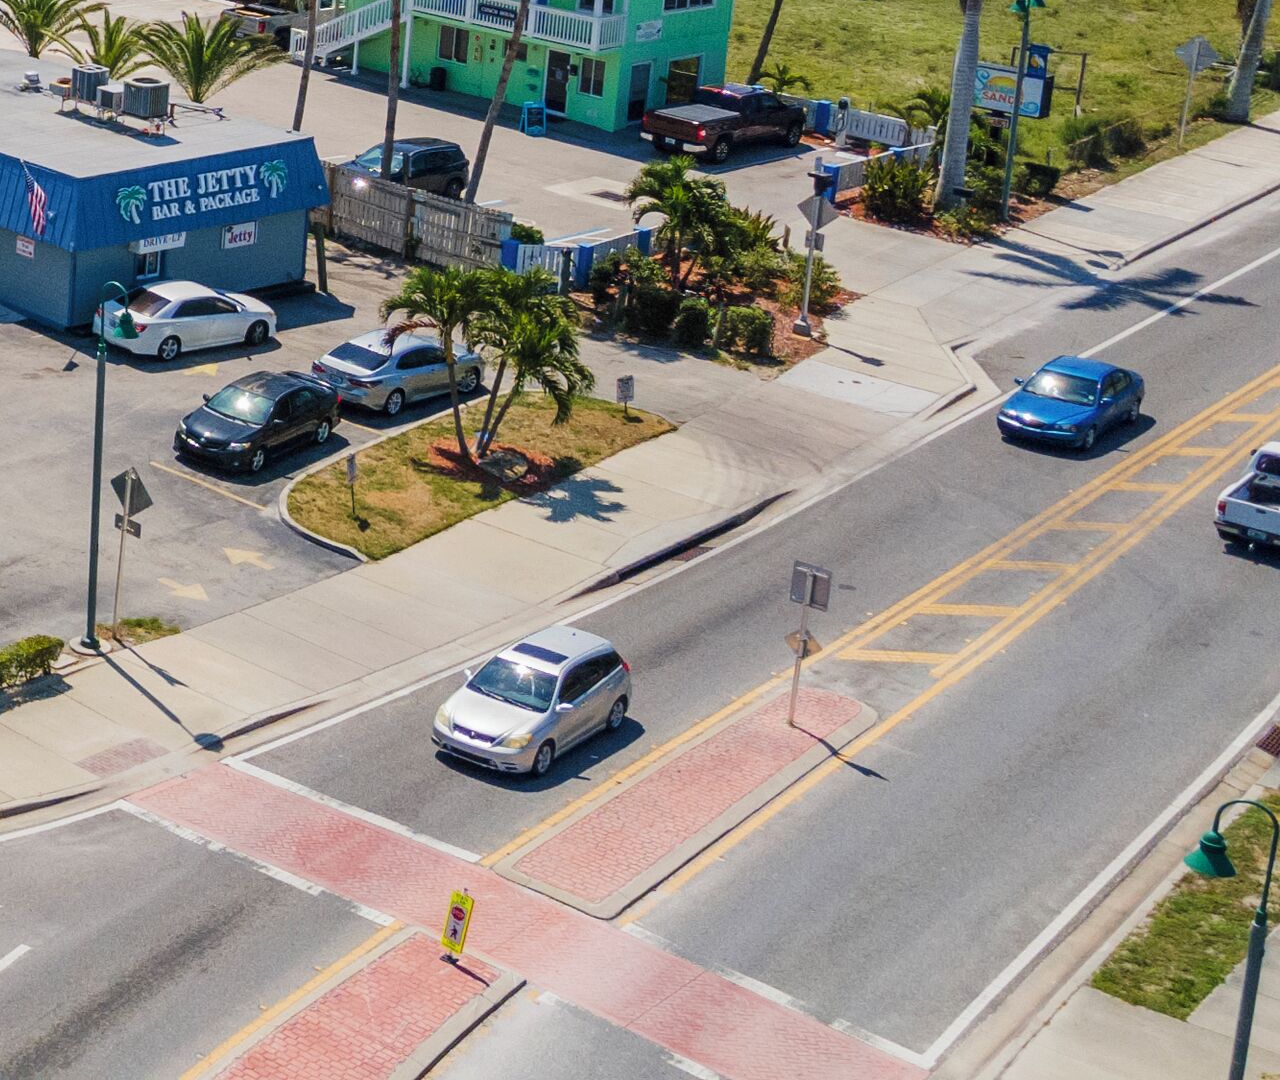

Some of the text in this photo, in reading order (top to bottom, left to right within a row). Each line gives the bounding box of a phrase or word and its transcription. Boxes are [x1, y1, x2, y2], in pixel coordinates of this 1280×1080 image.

[148, 165, 258, 203] THE JETTY
[151, 188, 260, 221] BAR & PACKAGE
[228, 230, 253, 245] Jetty
